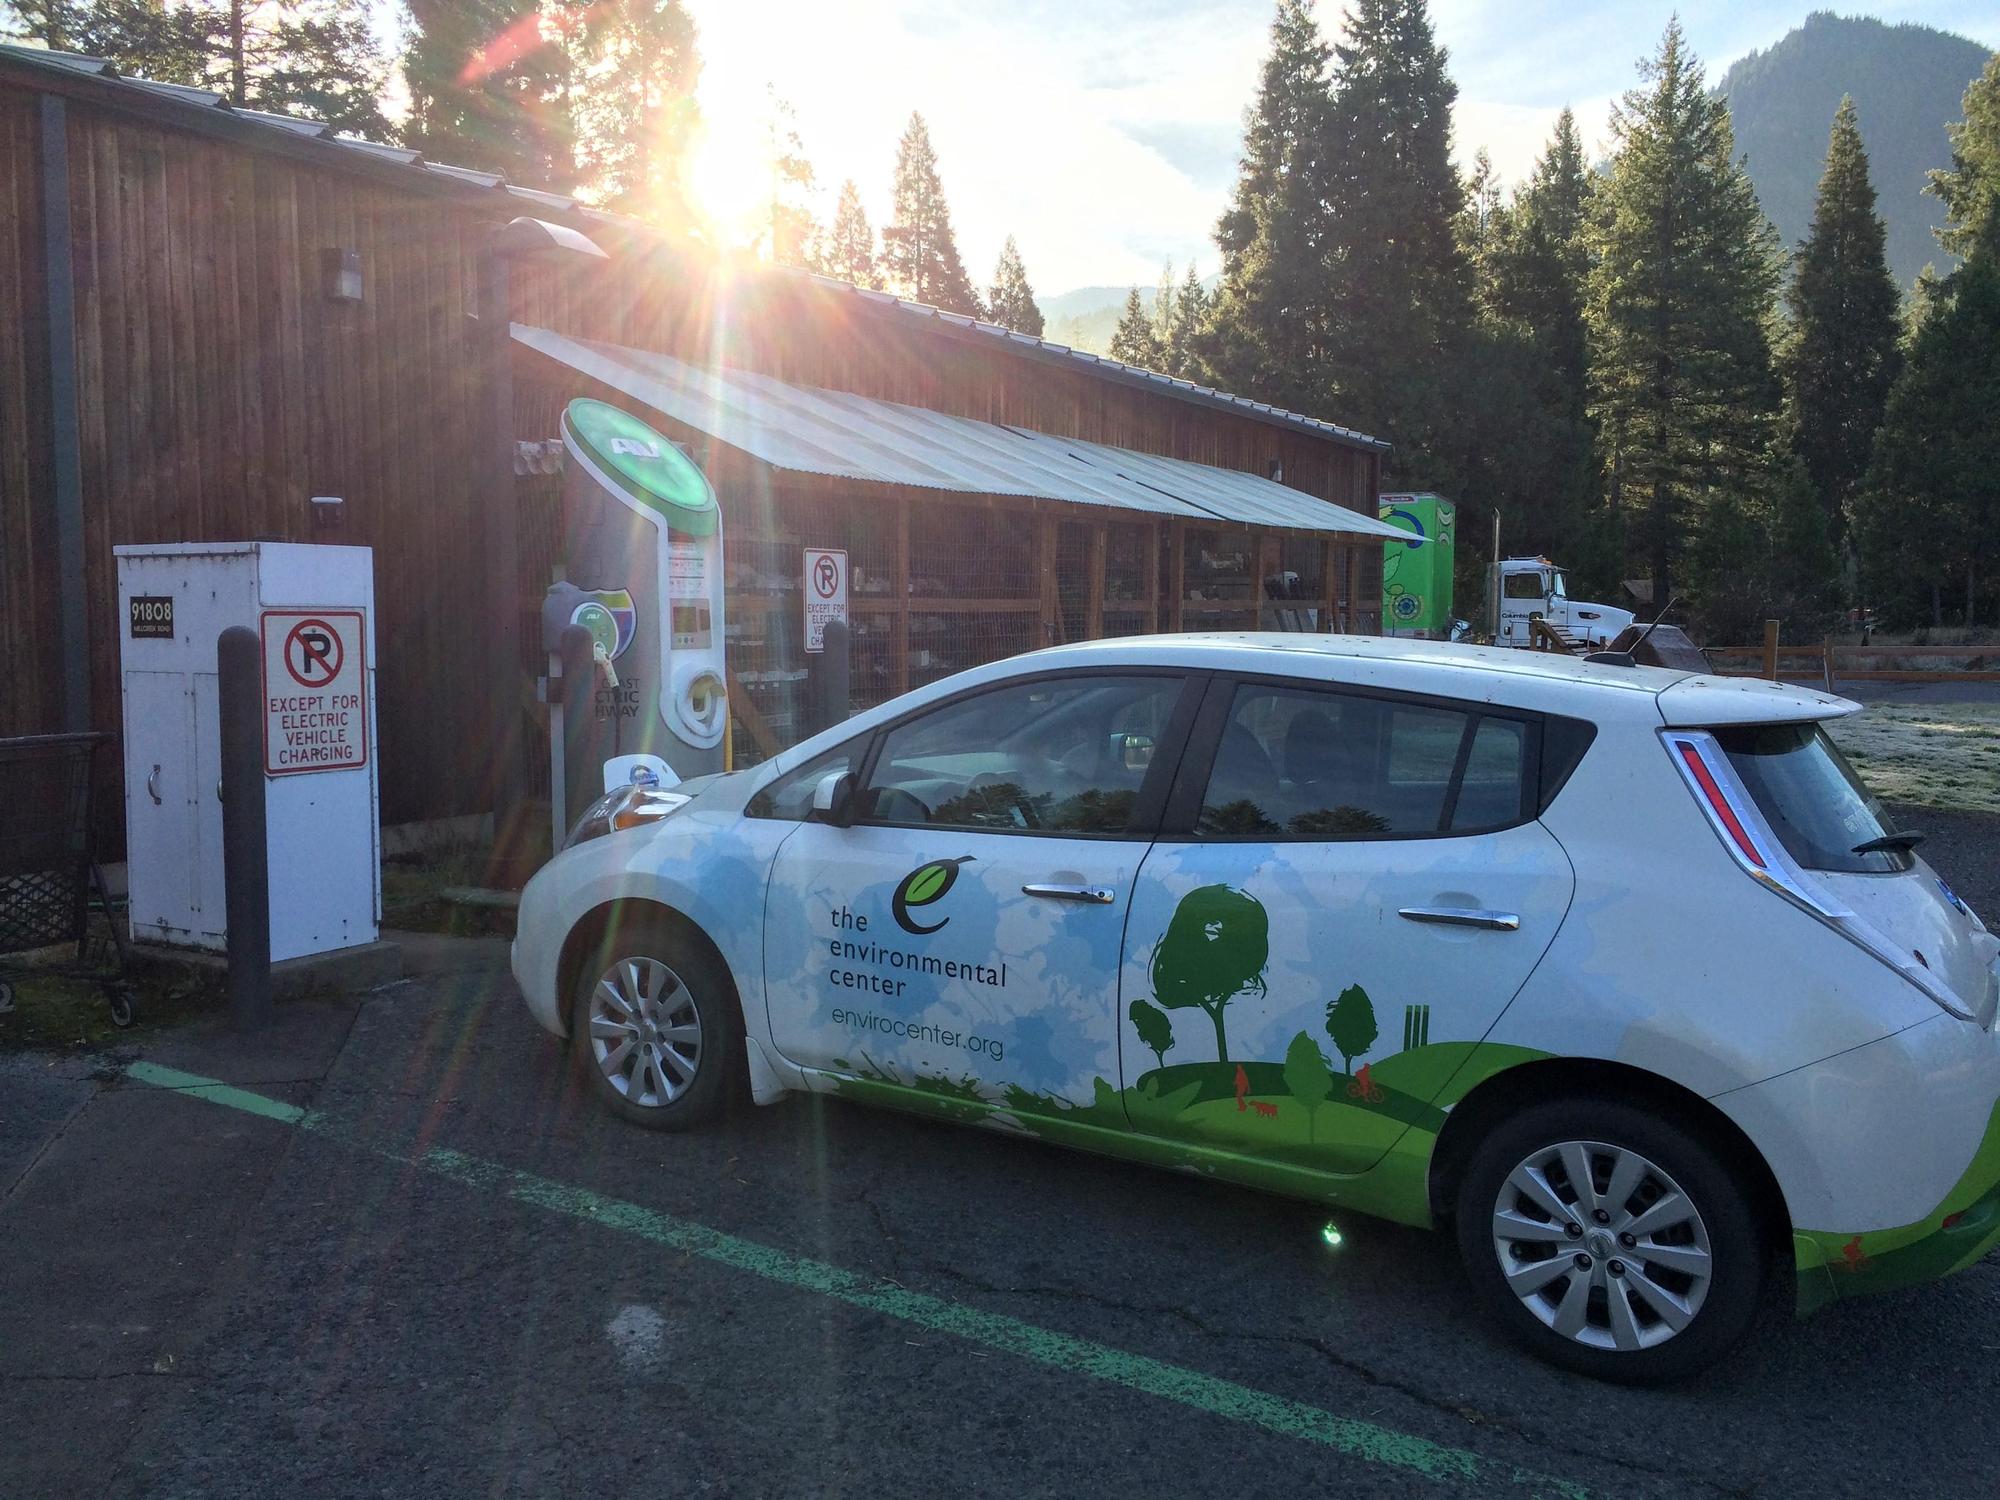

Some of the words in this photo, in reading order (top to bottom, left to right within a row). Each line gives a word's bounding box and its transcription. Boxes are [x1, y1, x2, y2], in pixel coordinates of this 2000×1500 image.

[132, 602, 172, 620] 91808
[808, 603, 831, 613] EXCEPT
[833, 603, 845, 613] FOR
[602, 678, 640, 689] CAST
[270, 696, 324, 712] EXCEPT
[332, 695, 359, 710] FOR
[282, 712, 348, 729] ELECTRIC
[286, 729, 346, 746] VEHICLE
[279, 745, 353, 764] CHARGING
[830, 905, 868, 932] the
[830, 940, 1007, 988] environmental
[830, 969, 906, 997] center
[832, 1007, 1004, 1062] envirocenter.org
